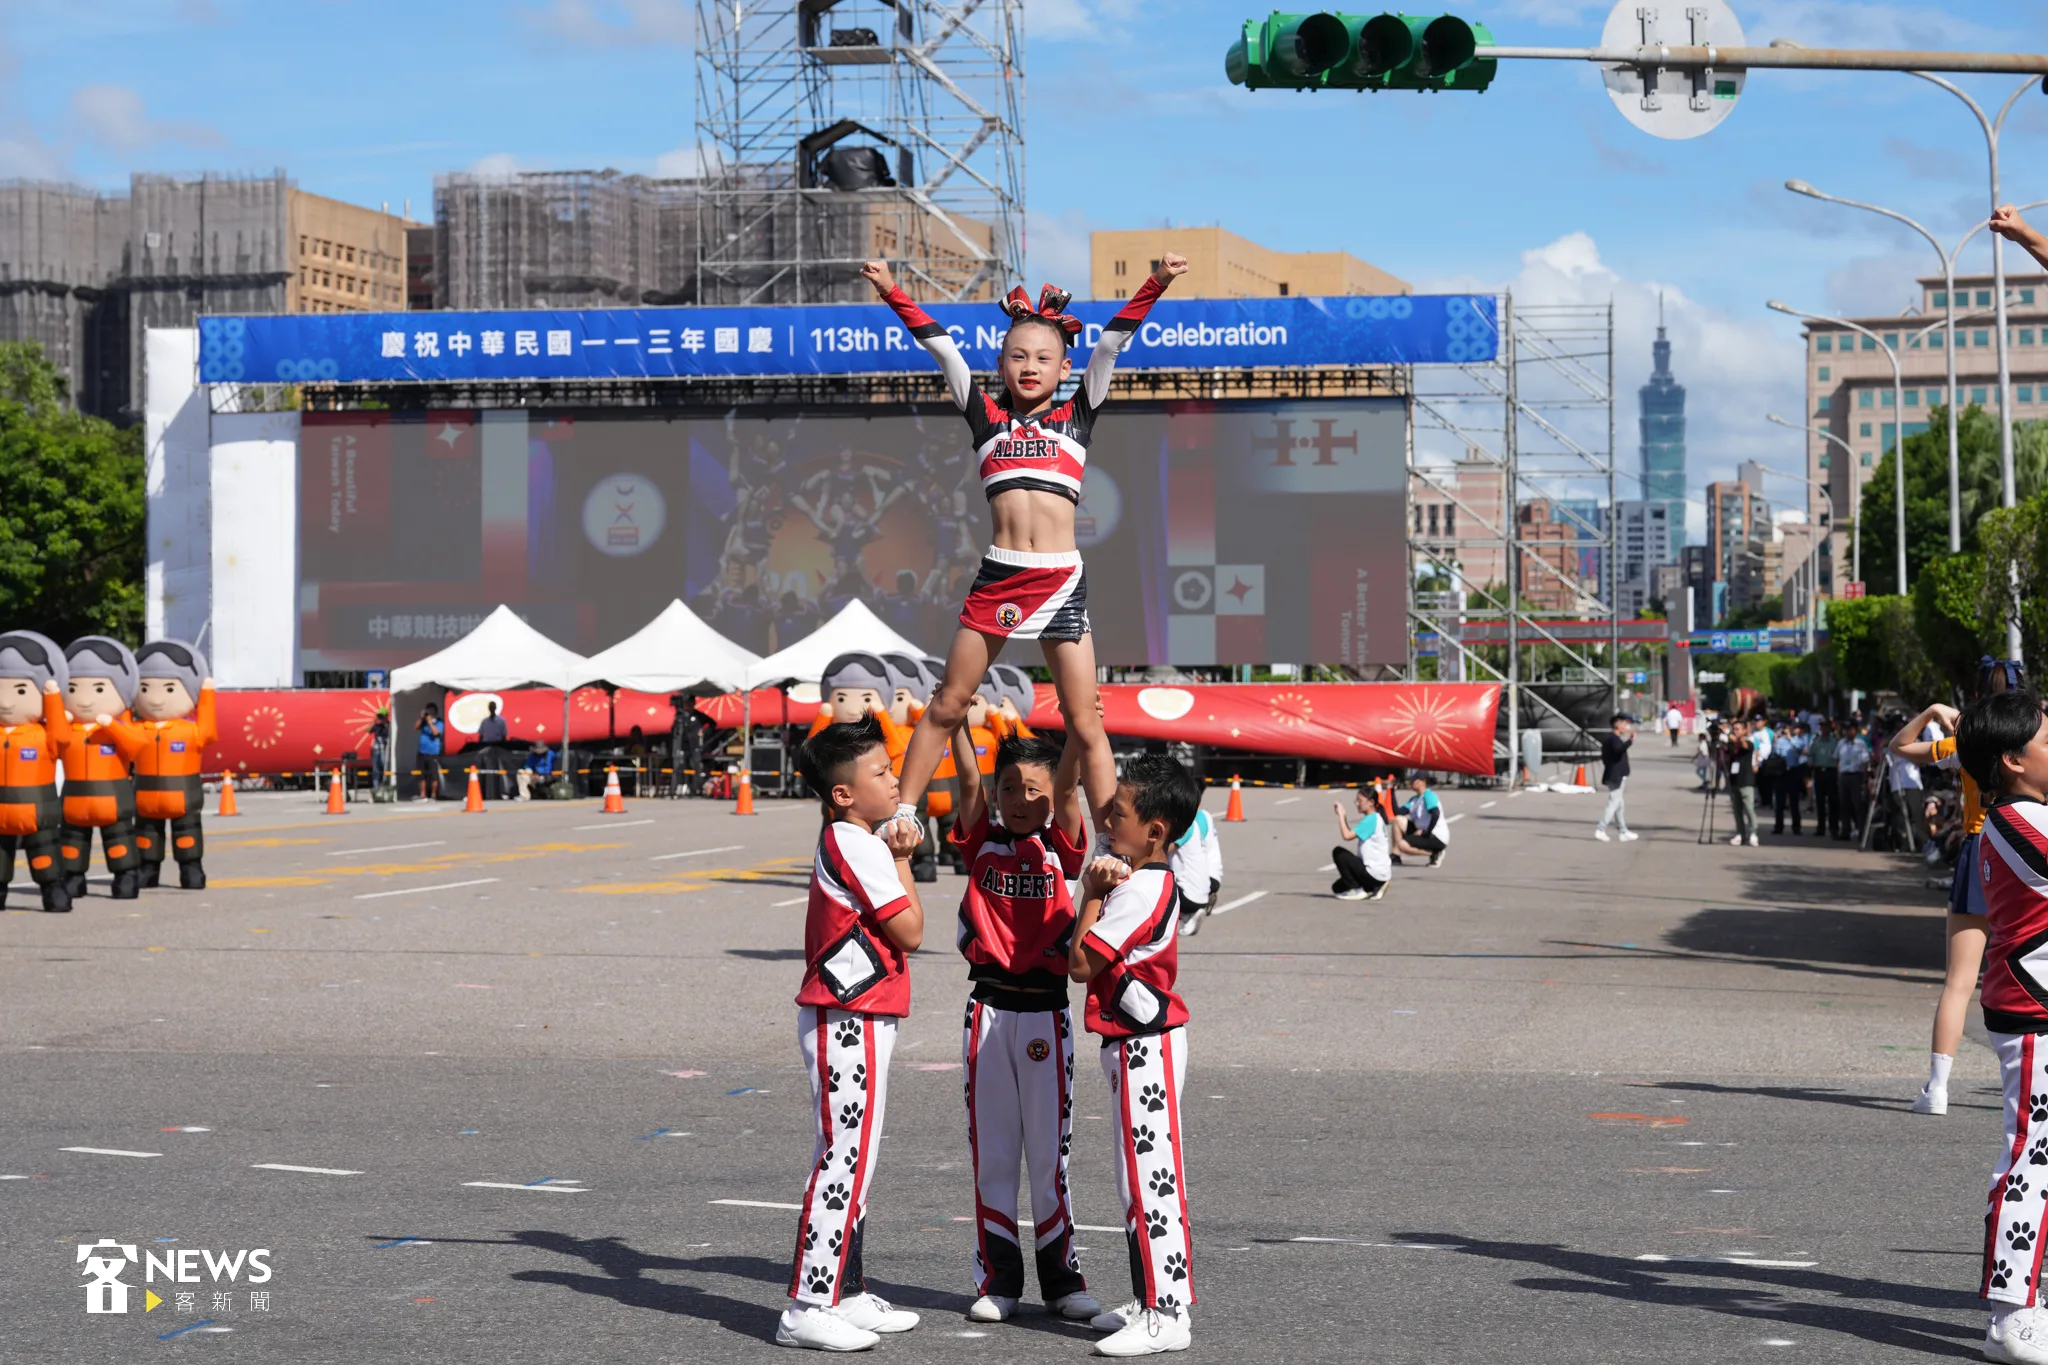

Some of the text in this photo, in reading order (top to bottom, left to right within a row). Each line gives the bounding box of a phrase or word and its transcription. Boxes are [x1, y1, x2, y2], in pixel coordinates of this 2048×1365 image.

[381, 326, 773, 357] 慶祝中華民國一一三年國慶
[810, 327, 879, 352] 113th
[1141, 322, 1287, 346] Celebration
[992, 439, 1061, 459] ALBERT
[981, 866, 1055, 898] ALBERT
